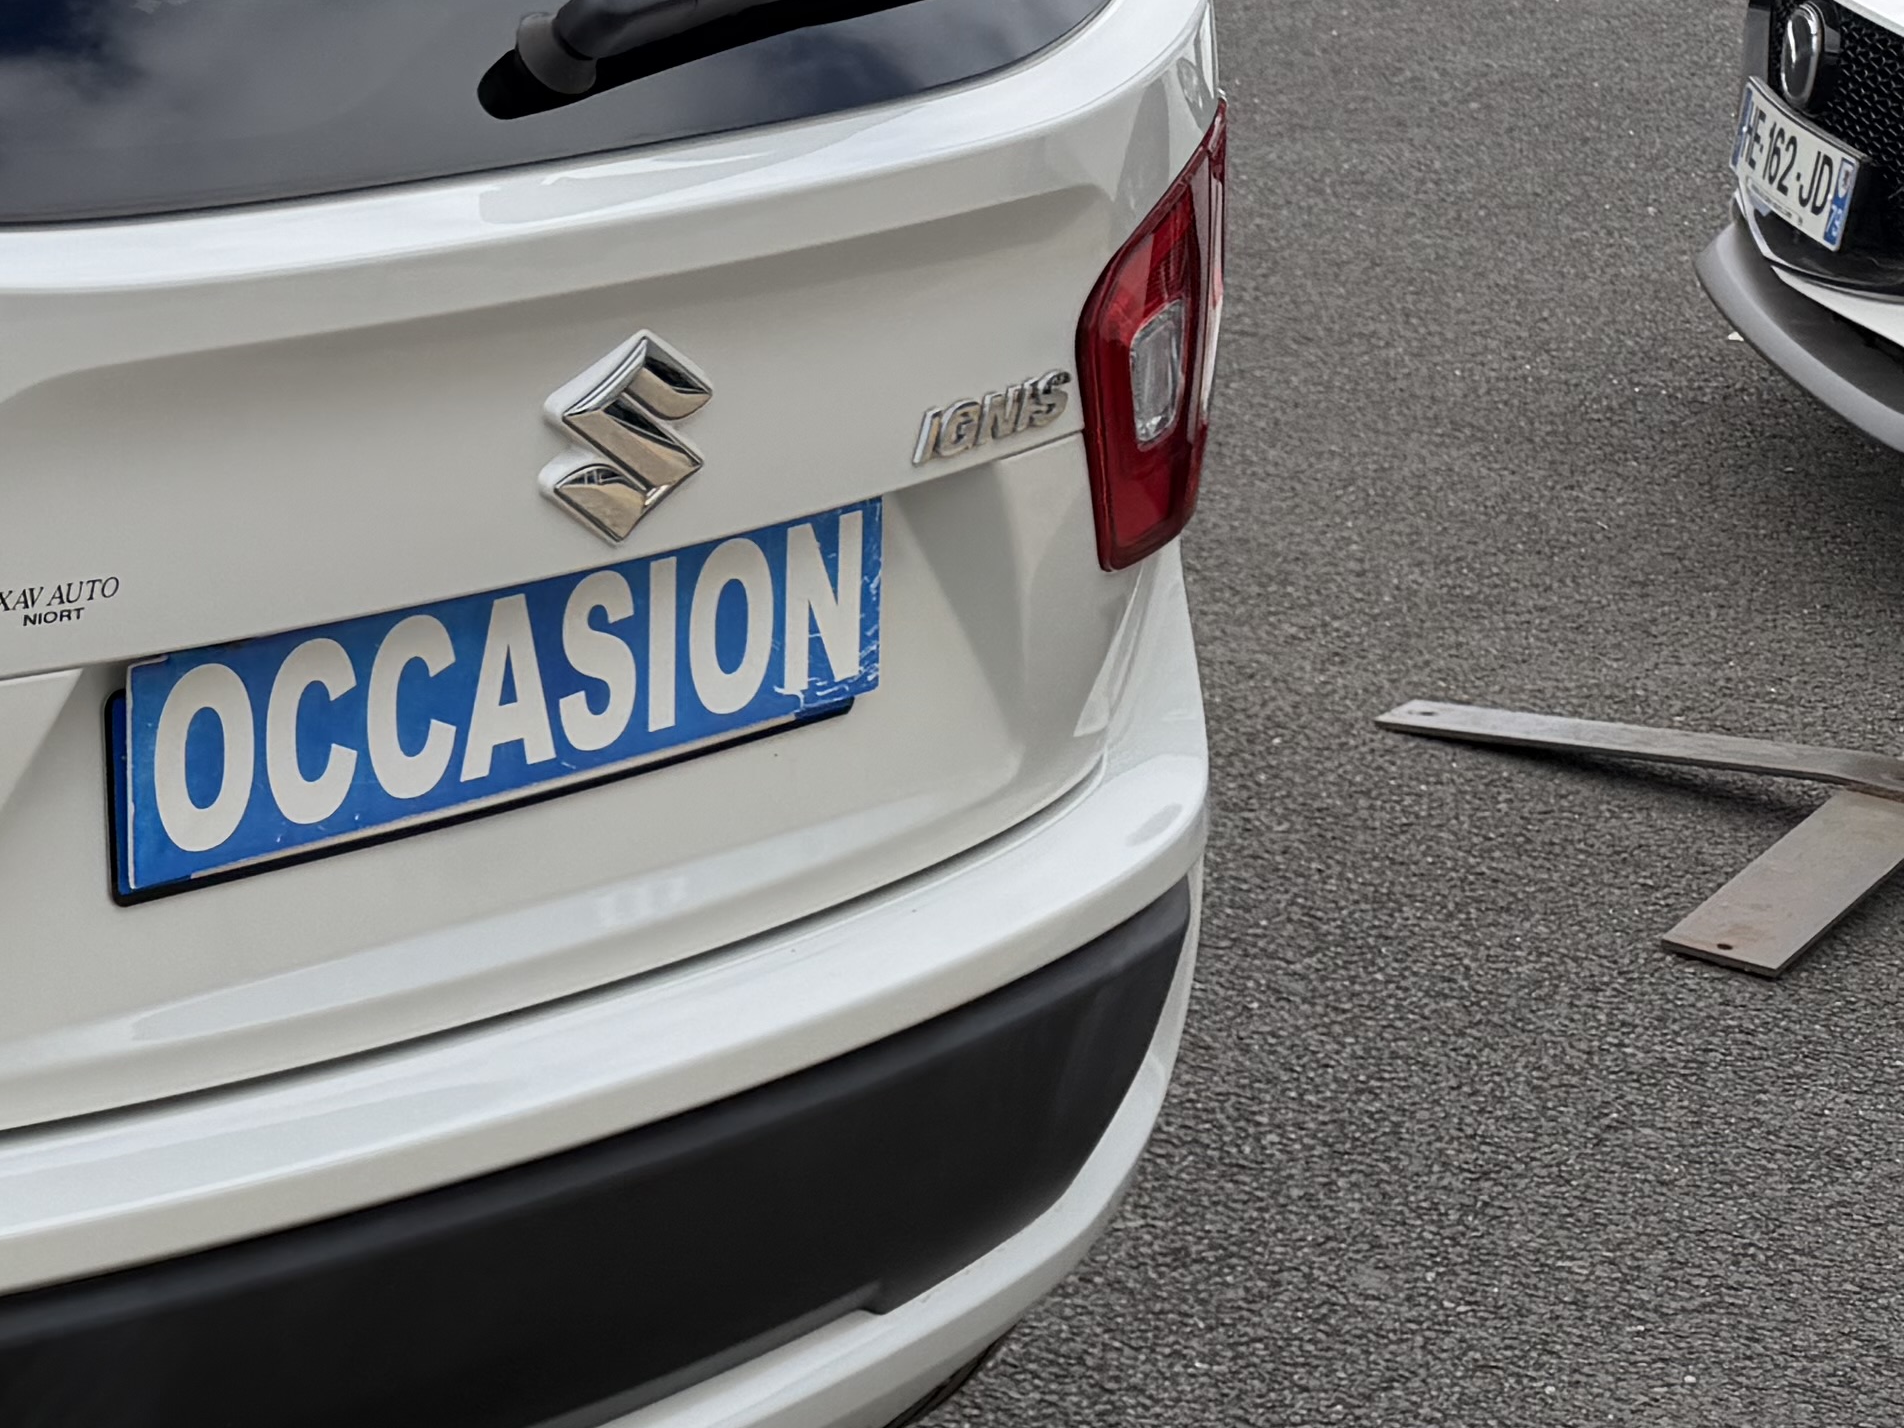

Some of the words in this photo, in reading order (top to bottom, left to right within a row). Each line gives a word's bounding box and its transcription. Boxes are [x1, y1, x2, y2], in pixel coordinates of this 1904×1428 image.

[912, 369, 1071, 467] IGNIS
[23, 607, 85, 627] NIORT
[46, 576, 120, 607] AUTO
[154, 510, 863, 853] OCCASION
